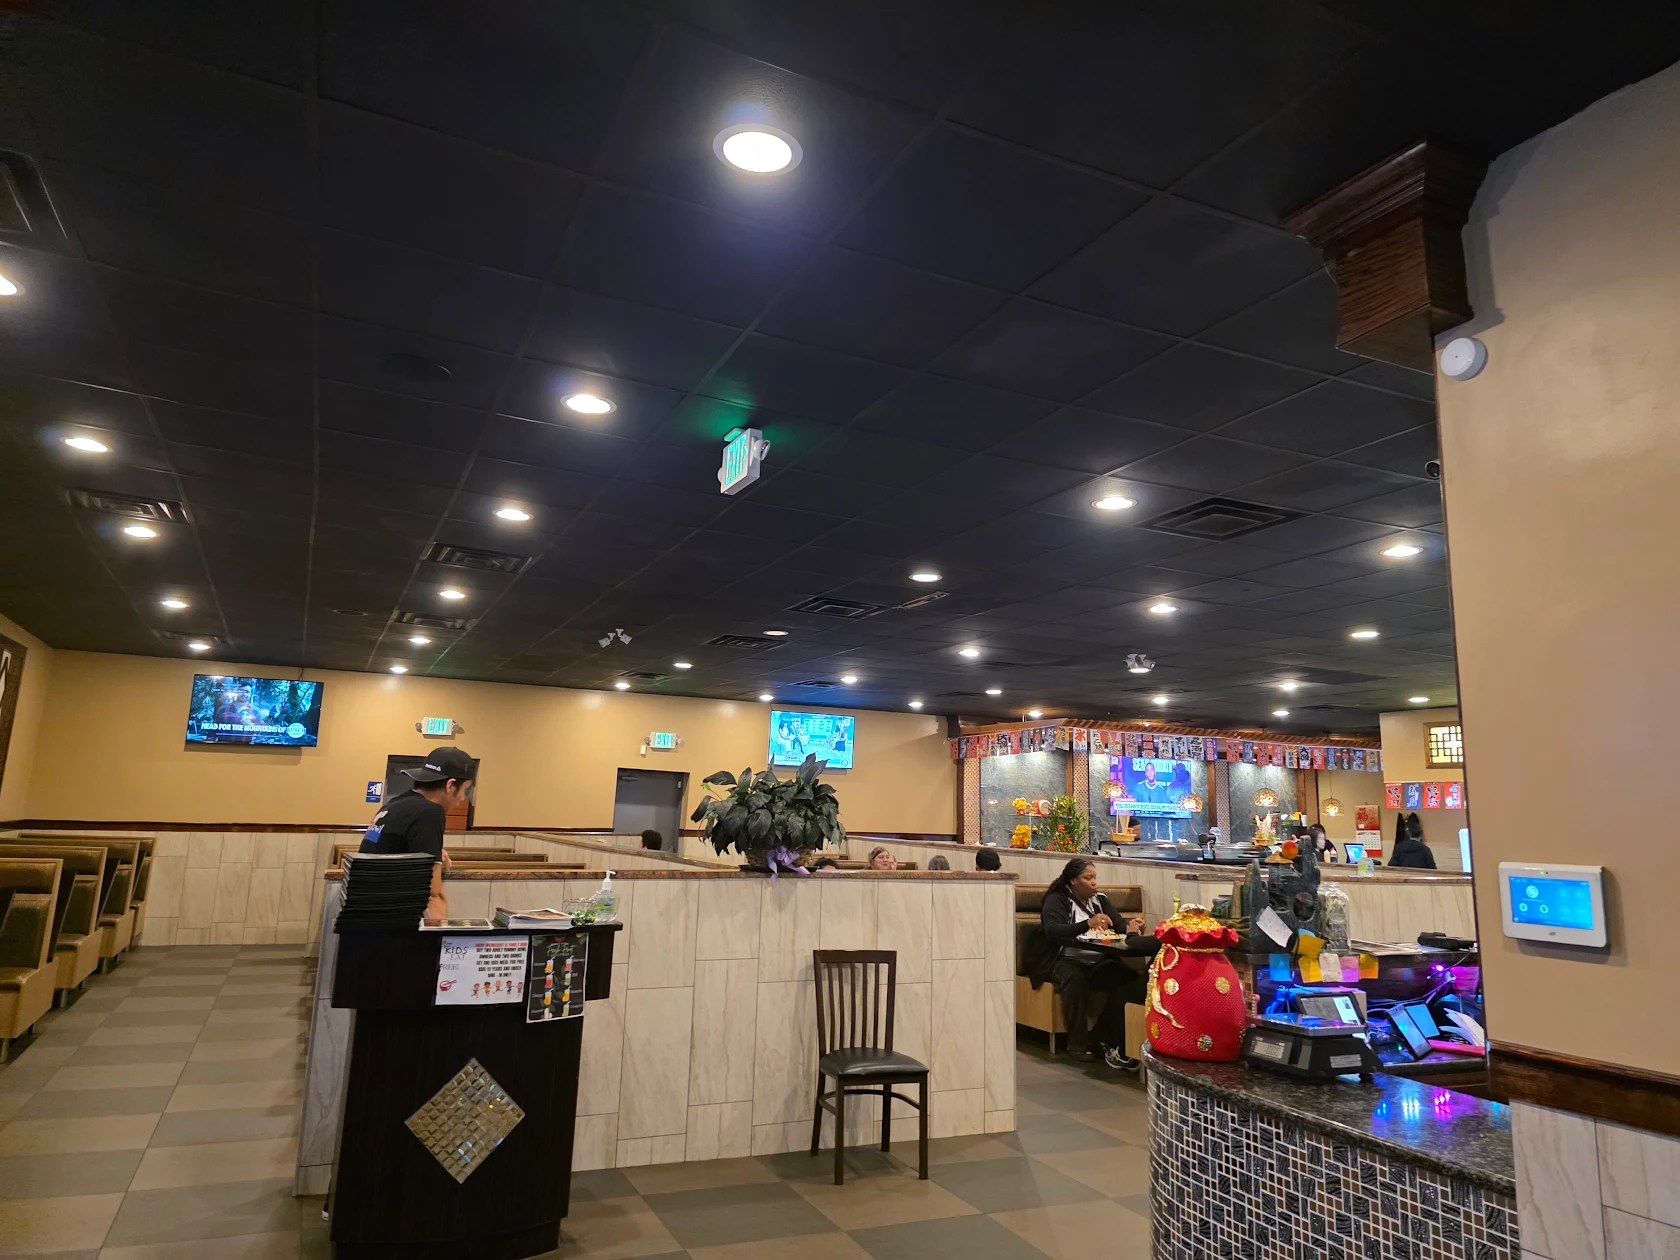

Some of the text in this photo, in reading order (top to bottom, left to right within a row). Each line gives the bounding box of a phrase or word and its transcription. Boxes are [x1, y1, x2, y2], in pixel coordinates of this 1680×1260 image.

[726, 434, 747, 485] EXIT
[201, 722, 218, 730] HEAD
[218, 723, 232, 731] FOR
[428, 717, 449, 734] EXIT
[655, 732, 673, 747] EXIT
[445, 945, 468, 954] KIDS
